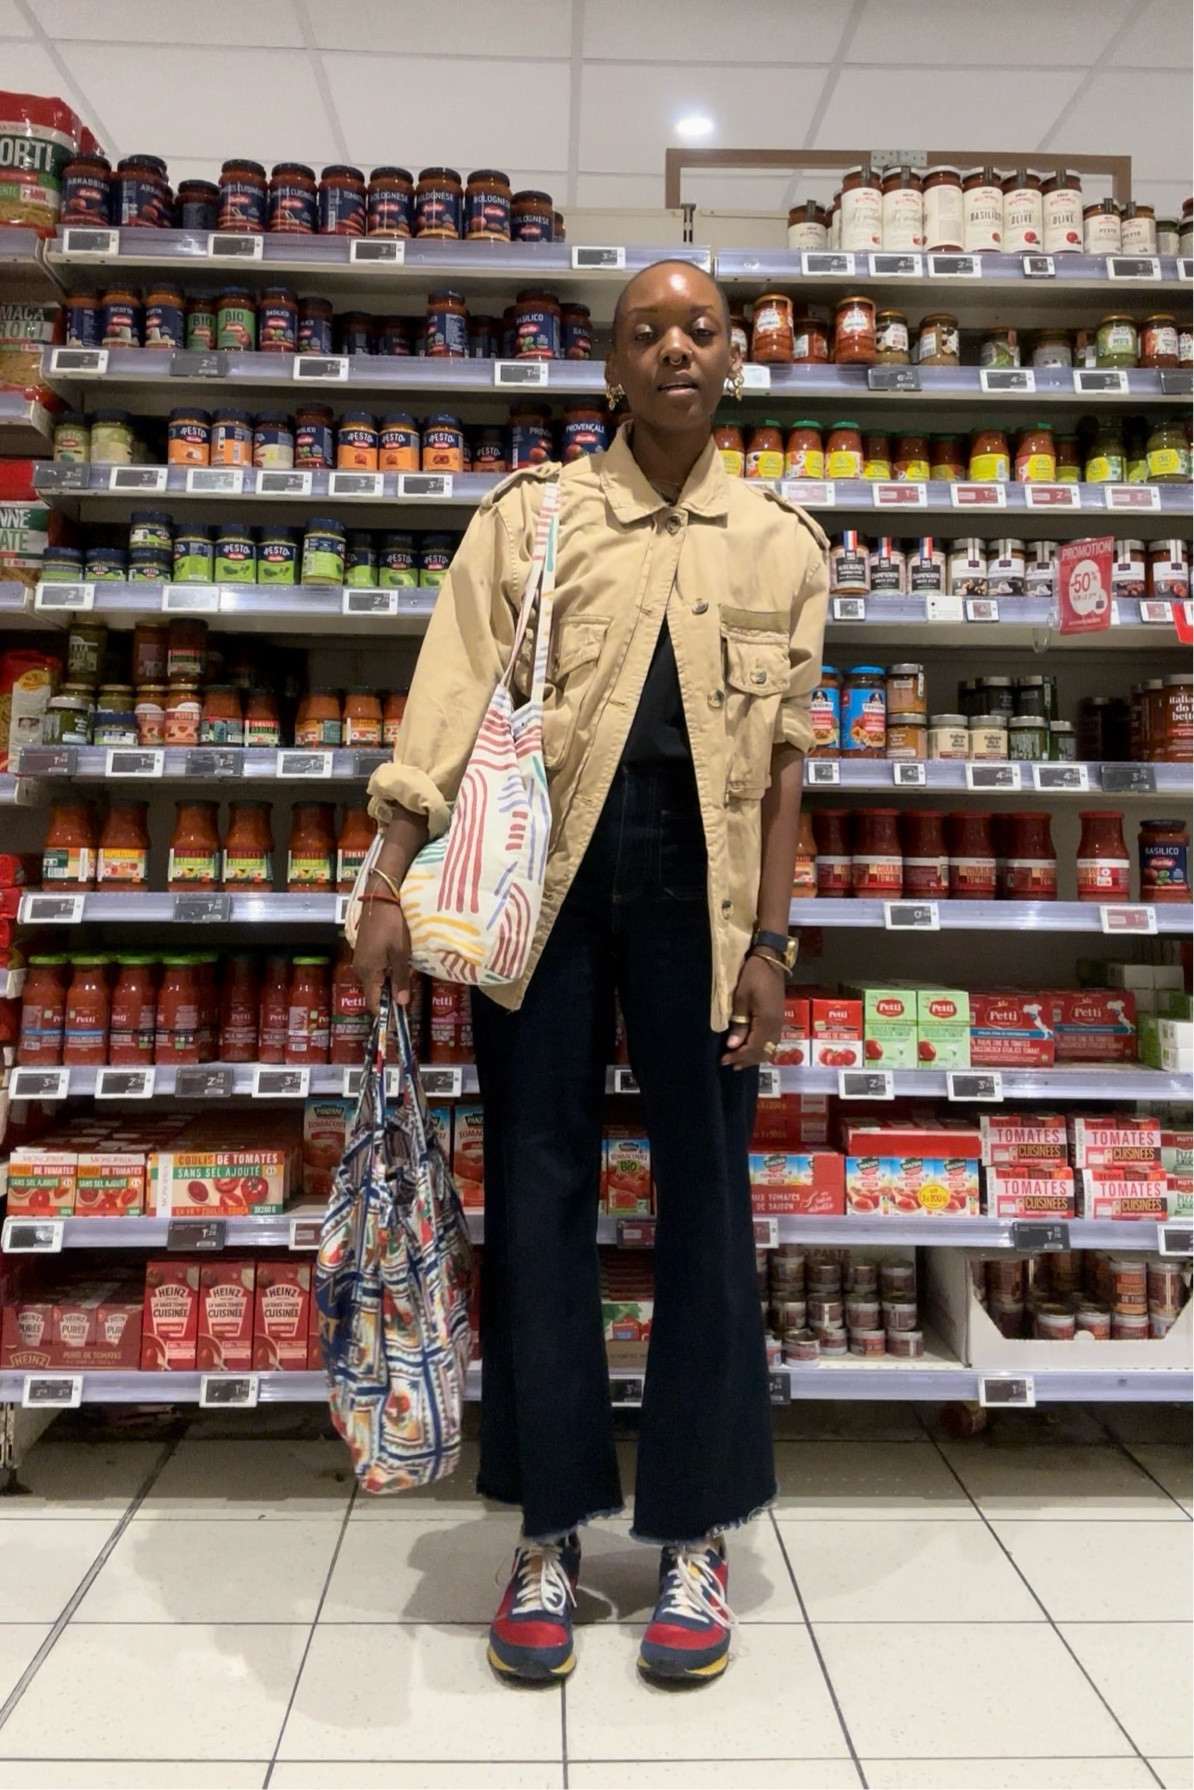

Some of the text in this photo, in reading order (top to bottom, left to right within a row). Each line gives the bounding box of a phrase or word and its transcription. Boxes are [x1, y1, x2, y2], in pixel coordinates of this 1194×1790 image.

[1011, 214, 1033, 224] OLIVE
[1053, 214, 1075, 224] OLIVE
[193, 315, 212, 327] BIO
[225, 310, 244, 323] BIO
[182, 427, 207, 438] PESTO
[350, 431, 373, 443] PESTO
[382, 432, 404, 442] PESTO
[430, 432, 454, 443] PESTO
[224, 544, 250, 554] PESTO
[264, 546, 290, 556] PESTO
[1062, 540, 1113, 560] PROMOTION
[387, 553, 412, 563] PESTO
[424, 555, 448, 564] PESTO
[1145, 847, 1179, 855] BASILICO
[341, 997, 366, 1007] Petti
[432, 996, 453, 1006] Petti
[880, 1003, 901, 1011] Petti
[931, 1004, 954, 1013] Petti
[269, 1013, 288, 1022] Petti
[828, 1011, 848, 1019] Petti
[990, 1011, 1017, 1021] Petti
[1074, 1008, 1102, 1018] Petti
[76, 1015, 96, 1023] Petti
[997, 1128, 1060, 1143] TOMATES
[1092, 1131, 1154, 1146] TOMATES
[178, 1153, 278, 1166] COULIS DE TOMATES
[33, 1166, 75, 1175] DE TOMATES
[101, 1166, 142, 1176] DE TOMATES
[178, 1166, 260, 1178] SANS SEL AJOUTÉ
[10, 1178, 25, 1187] SANS
[26, 1178, 36, 1186] SEL
[79, 1178, 127, 1188] SANS SEL AJOUTÉ
[1003, 1180, 1067, 1195] TOMATES
[1100, 1182, 1161, 1197] TOMATES
[768, 1193, 801, 1201] TOMATES
[756, 1202, 795, 1211] DE SAISON
[158, 1287, 186, 1298] HEINZ
[213, 1287, 241, 1298] HEINZ
[269, 1287, 297, 1298] HEINZ
[153, 1308, 188, 1318] CUISINÉE
[208, 1308, 243, 1318] CUISINÉE
[264, 1308, 299, 1318] CUISINÉE
[61, 1323, 87, 1333] PURÉE
[83, 1351, 122, 1360] DE TOMATES
[14, 1356, 46, 1367] HEINZ
